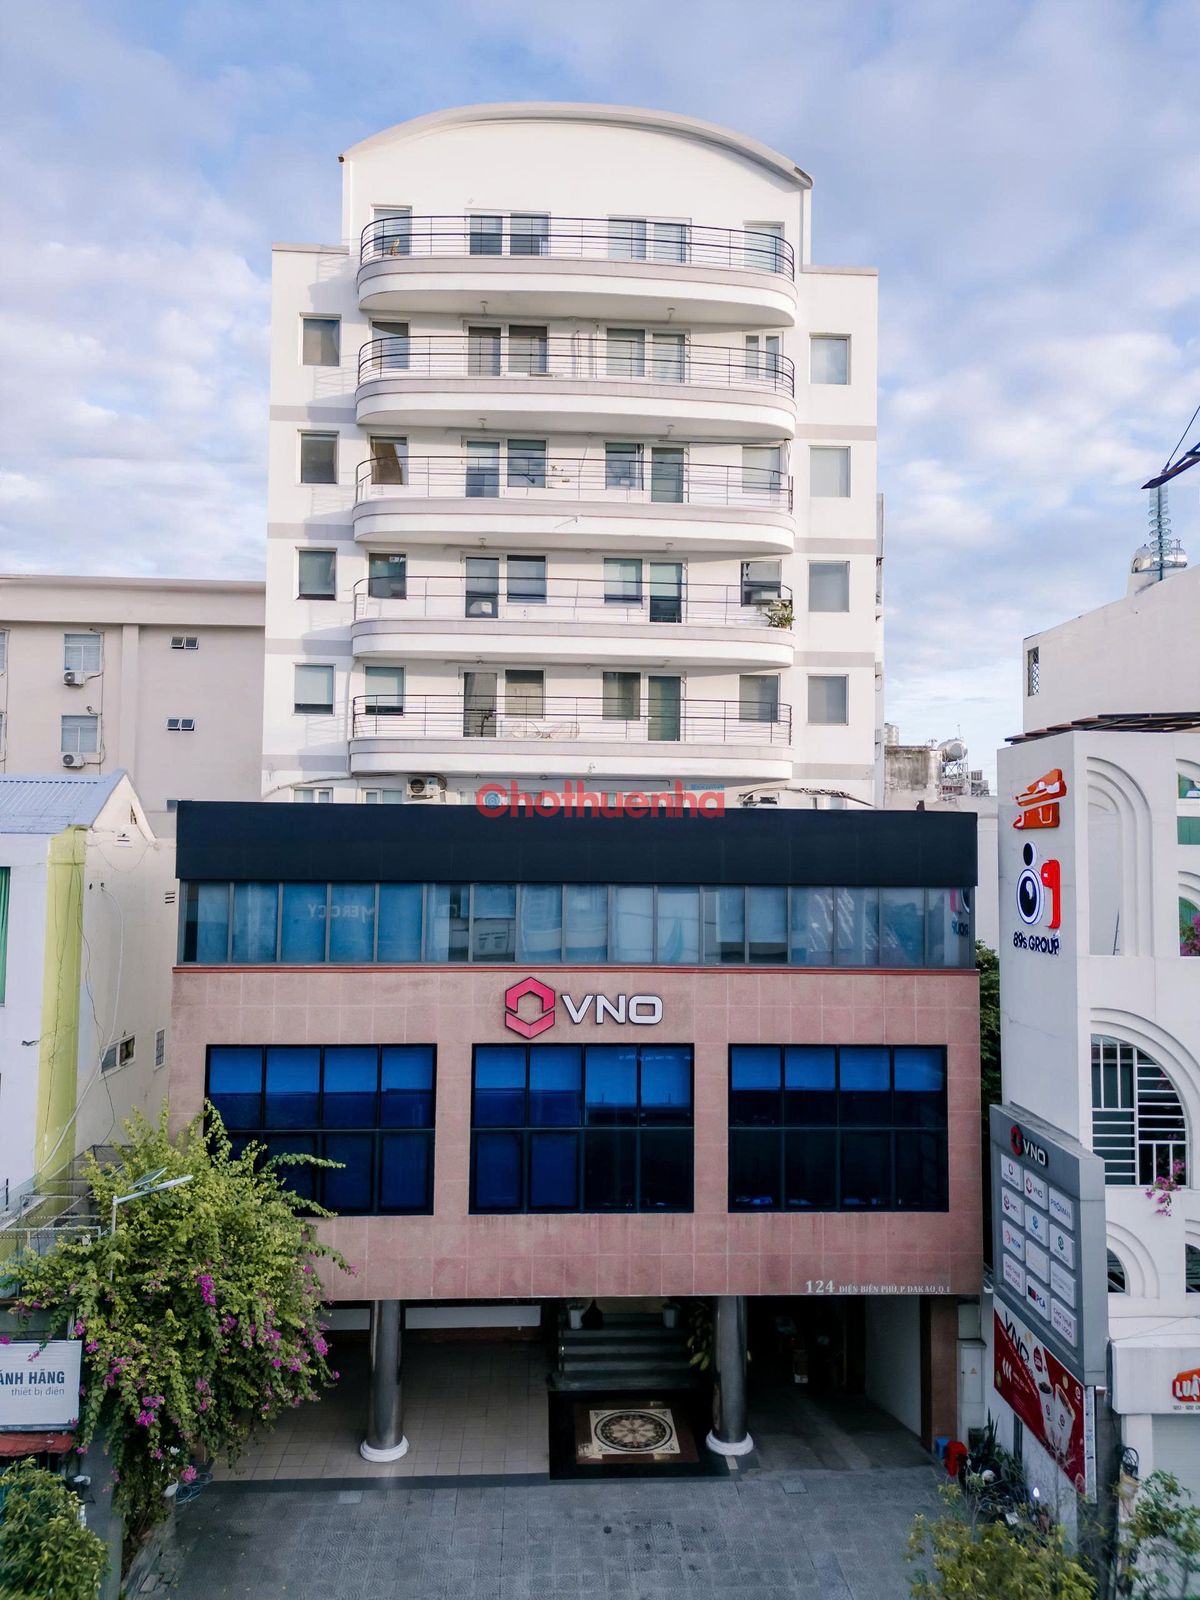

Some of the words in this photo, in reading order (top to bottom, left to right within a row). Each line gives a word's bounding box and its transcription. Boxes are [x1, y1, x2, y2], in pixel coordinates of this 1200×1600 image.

[1029, 935, 1060, 955] GROUP
[561, 994, 663, 1024] VNO
[1022, 1139, 1047, 1167] VNO
[806, 1280, 835, 1293] 124
